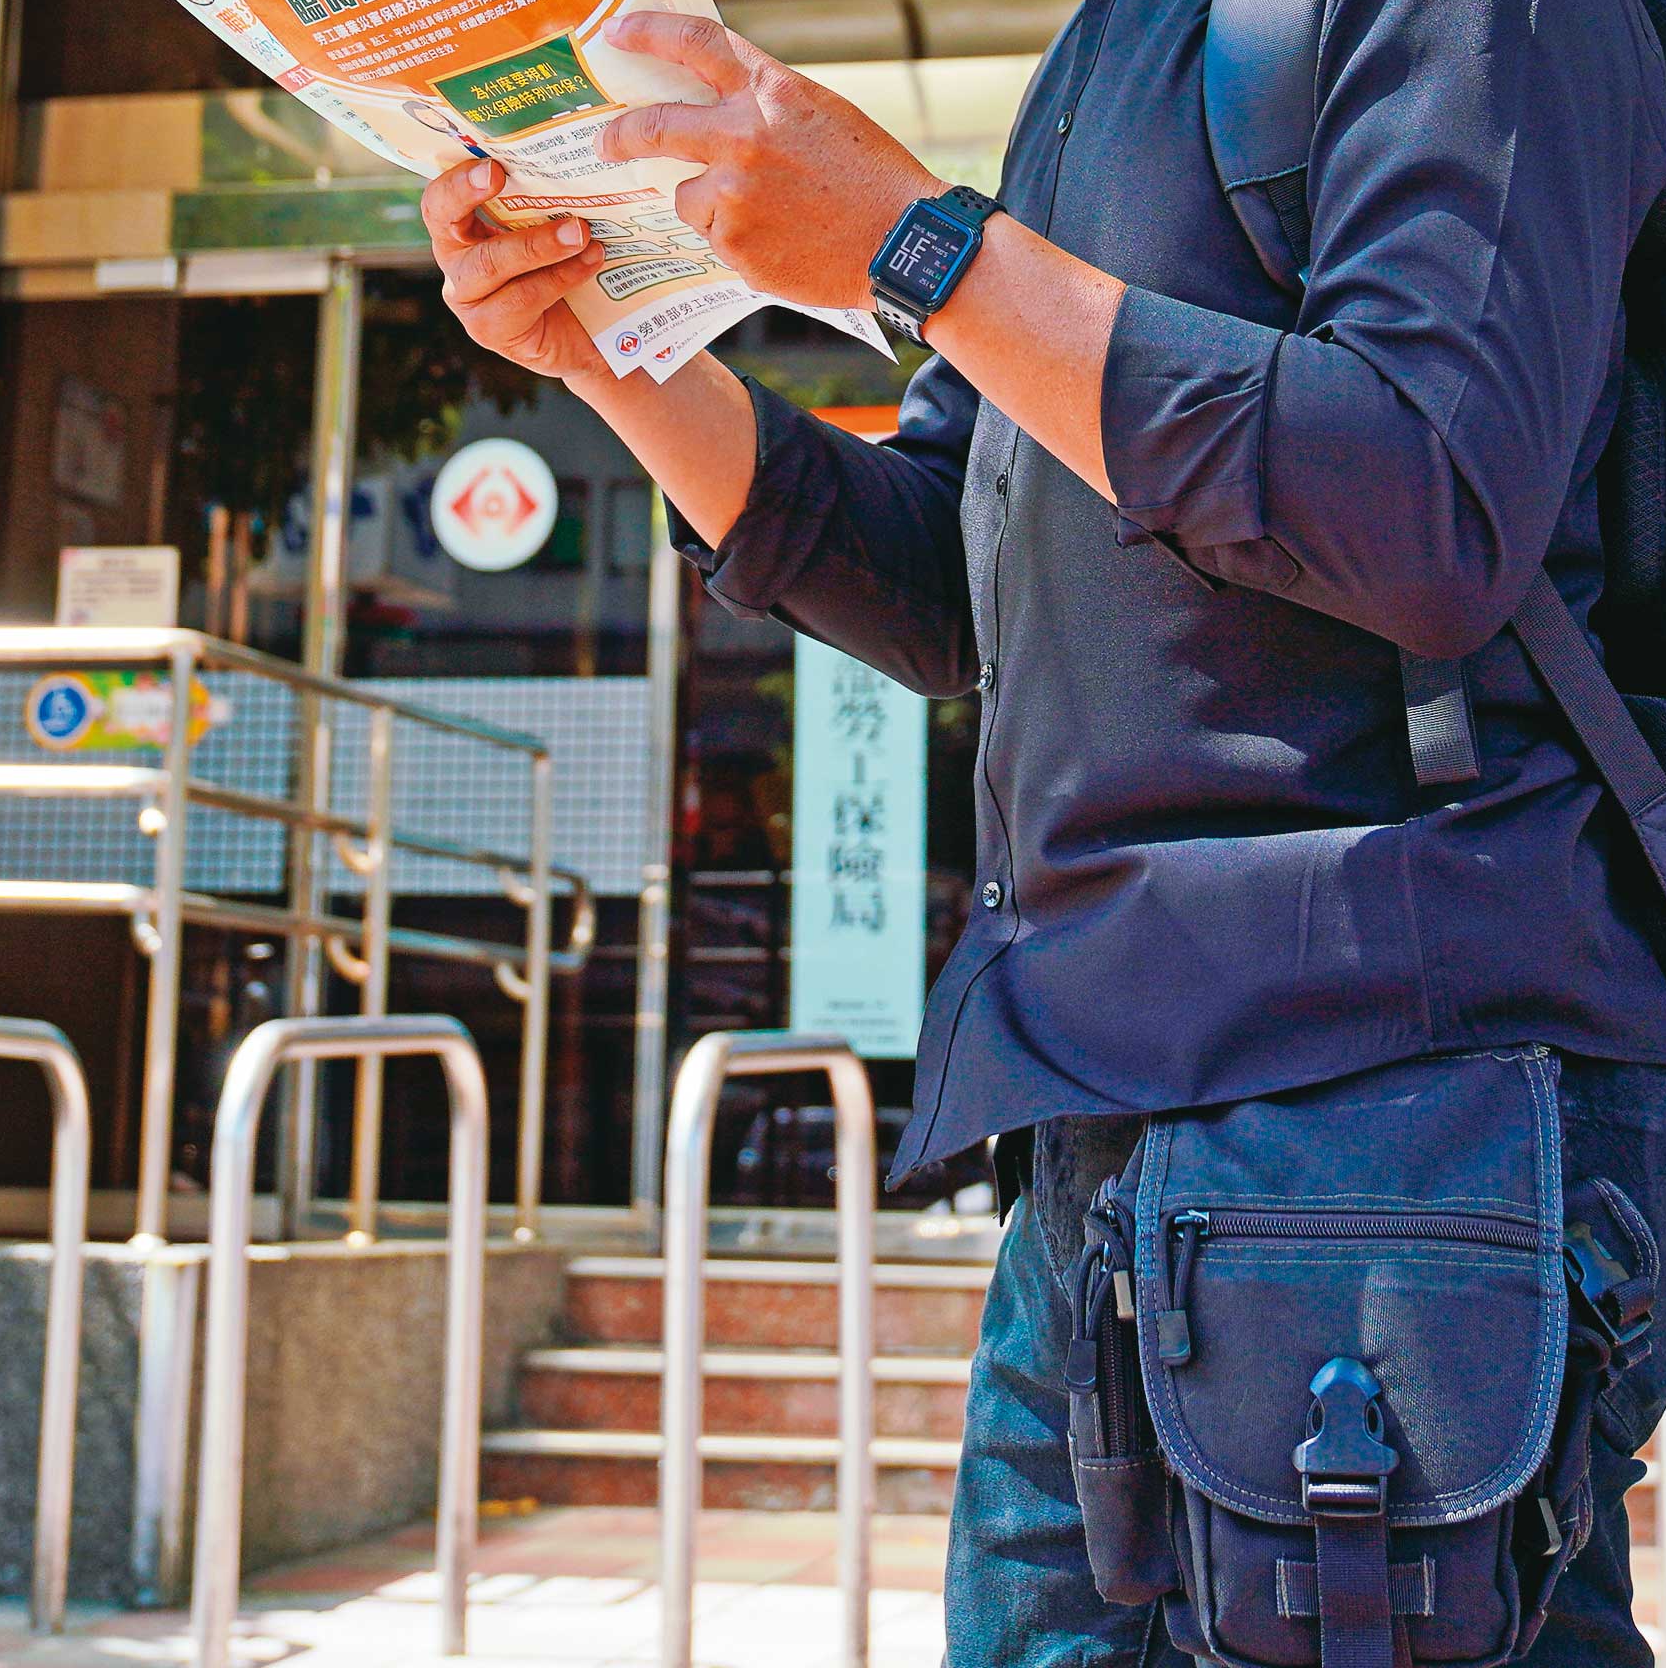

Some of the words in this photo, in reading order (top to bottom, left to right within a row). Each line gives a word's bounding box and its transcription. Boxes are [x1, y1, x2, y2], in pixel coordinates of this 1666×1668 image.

[471, 62, 558, 101] 為什麼要規劃
[900, 231, 931, 259] 37
[888, 249, 919, 277] 10
[637, 288, 742, 338] 勞動部勞工保險局
